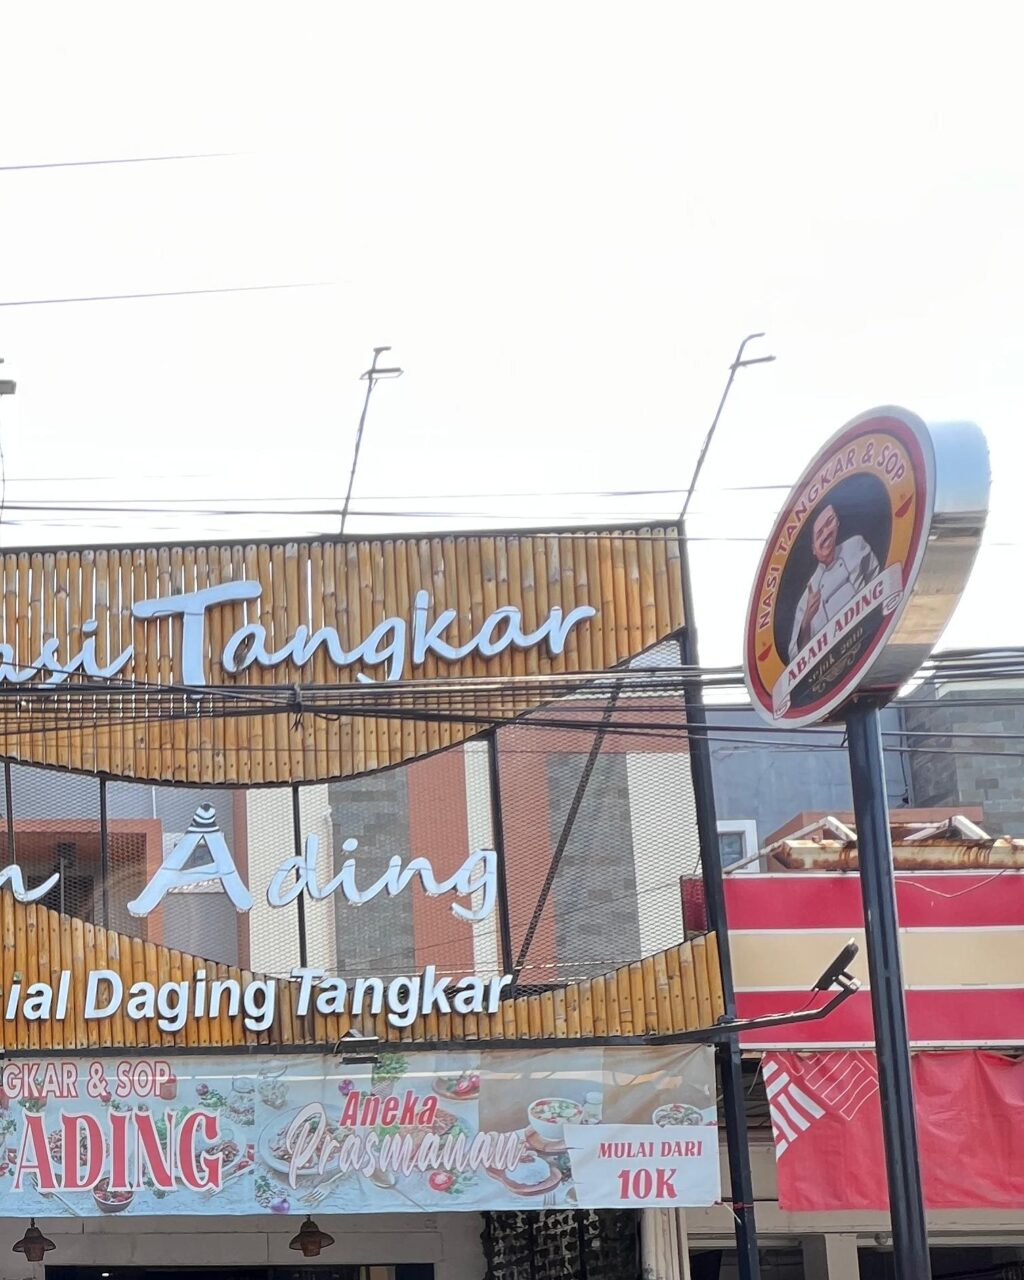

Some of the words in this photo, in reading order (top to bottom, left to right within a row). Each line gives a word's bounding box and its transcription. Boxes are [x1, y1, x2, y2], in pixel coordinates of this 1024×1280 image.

[758, 566, 780, 630] NASI
[776, 447, 857, 555] TANGKAR
[862, 442, 875, 465] &
[877, 443, 906, 484] SOP
[131, 579, 596, 700] Tangkar
[787, 632, 829, 686] ABAH
[831, 580, 885, 639] ADING
[127, 803, 499, 921] Ading
[84, 967, 276, 1033] Daging
[291, 964, 514, 1030] Tangkar
[86, 1063, 109, 1098] &
[115, 1060, 174, 1097] SOP
[338, 1088, 439, 1128] Aneka
[12, 1107, 225, 1194] ADING
[286, 1100, 526, 1190] Prasmanan
[597, 1140, 657, 1160] MULAI
[660, 1139, 704, 1158] DARI
[617, 1168, 678, 1201] 10K
